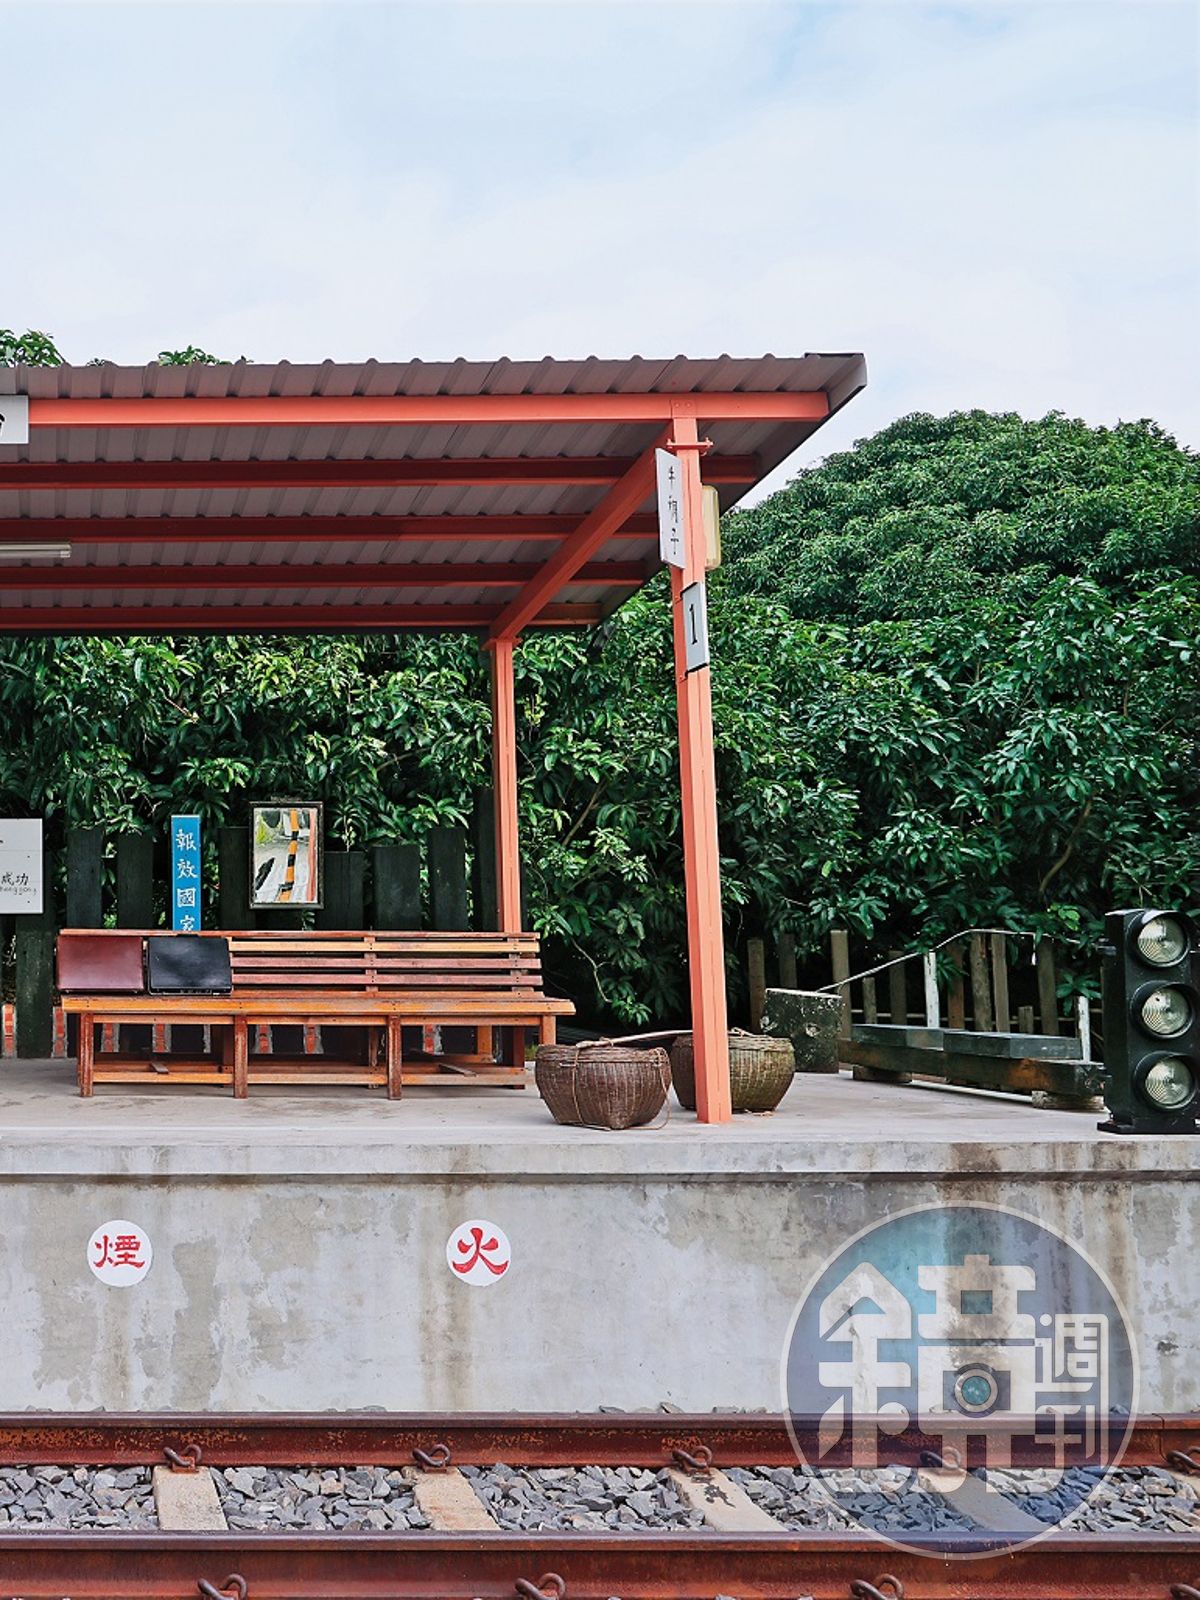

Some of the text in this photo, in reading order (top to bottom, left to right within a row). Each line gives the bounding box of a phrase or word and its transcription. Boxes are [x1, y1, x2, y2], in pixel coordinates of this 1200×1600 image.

[688, 603, 698, 645] 1
[0, 872, 30, 887] 成功
[175, 828, 198, 931] 報效國家
